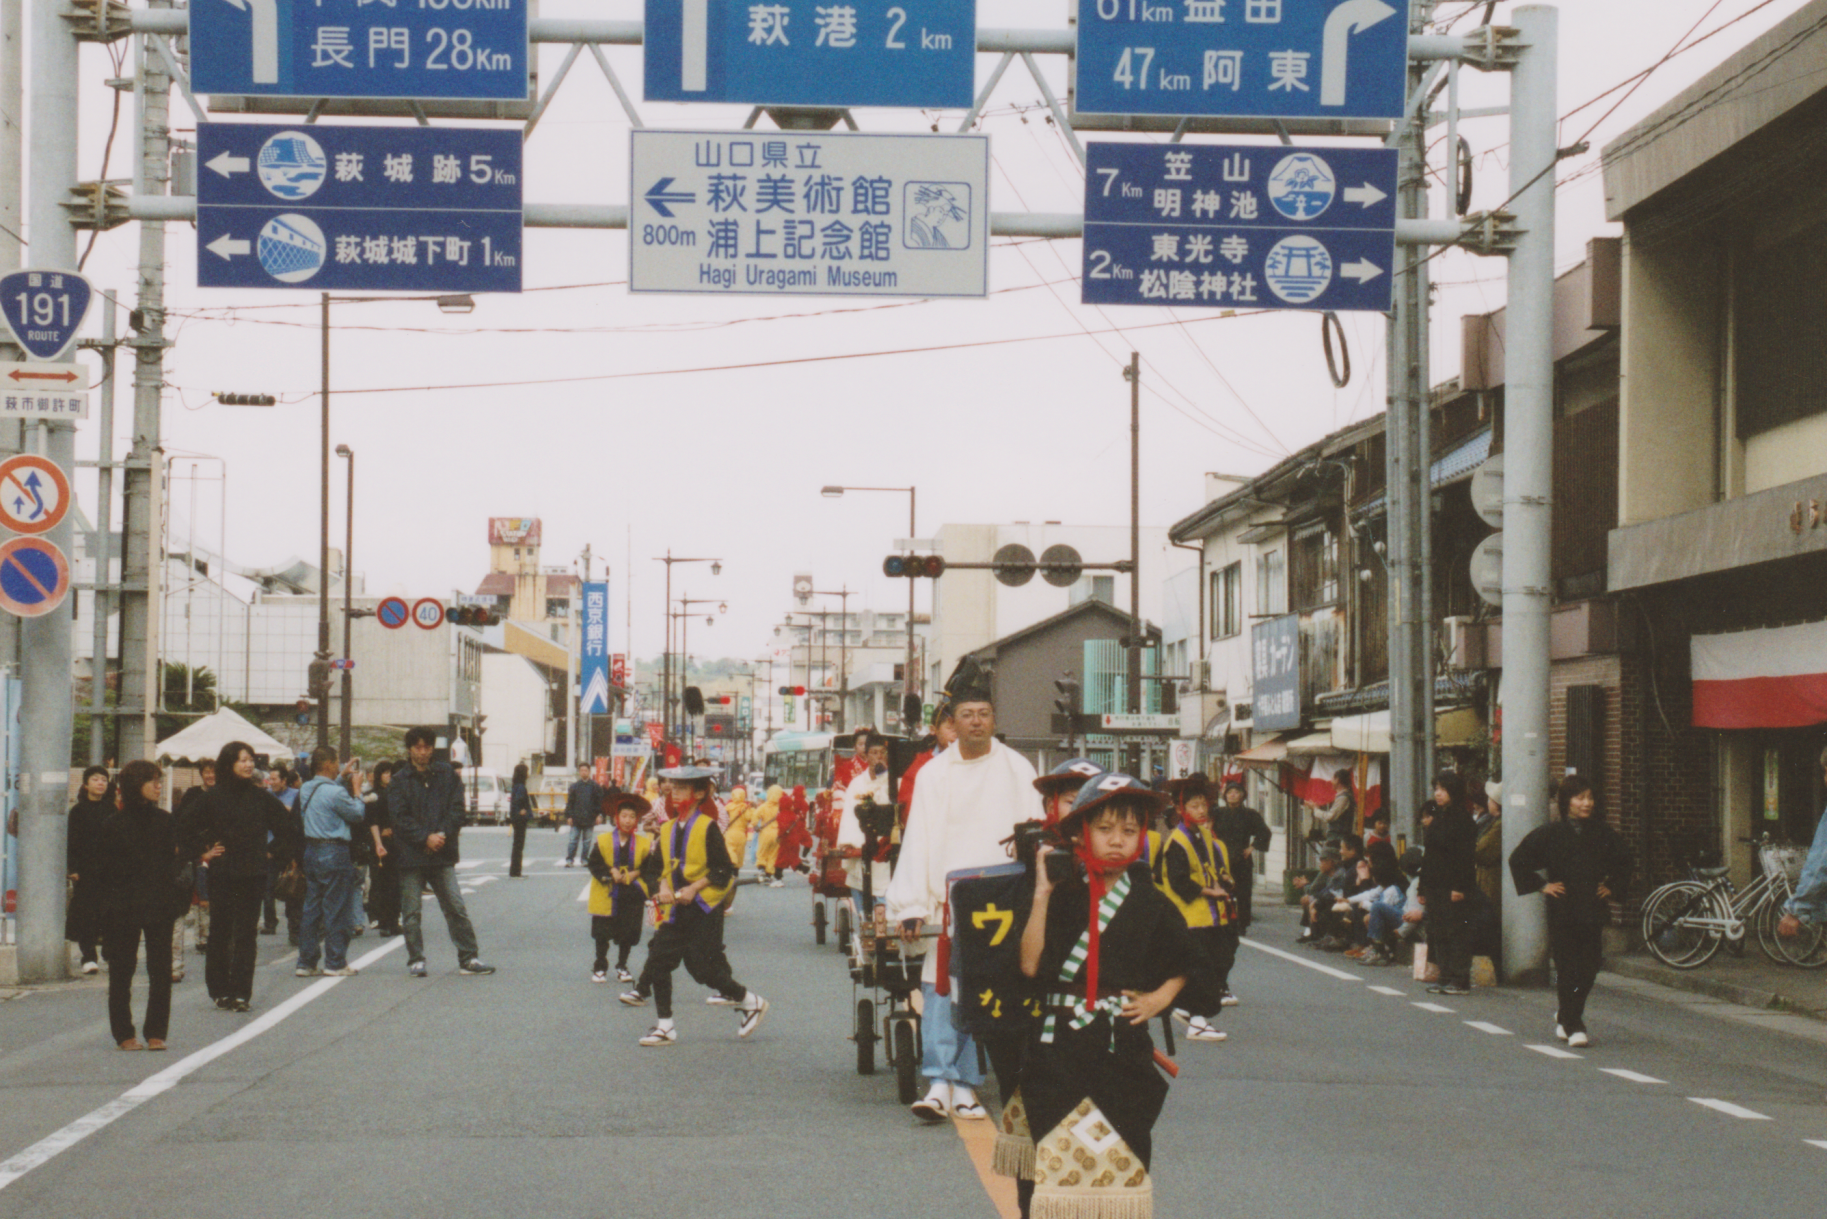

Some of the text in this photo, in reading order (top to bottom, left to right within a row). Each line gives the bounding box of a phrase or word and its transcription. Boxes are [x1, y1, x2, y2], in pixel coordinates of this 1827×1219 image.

[748, 4, 952, 50] 萩港 2 km
[311, 26, 409, 69] 長門
[1203, 49, 1311, 92] 阿東
[335, 153, 461, 184] 萩城跡
[695, 140, 823, 169] 山口県立
[1163, 151, 1251, 182] 笠山
[706, 173, 893, 216] 萩美術館
[1153, 188, 1258, 220] 明神池
[335, 235, 471, 266] 萩城城下町
[643, 224, 697, 247] 800m
[706, 218, 893, 262] 浦上記念館
[1151, 233, 1249, 264] 東光寺
[28, 273, 64, 289] 国道
[699, 263, 898, 290] Hagi Uragami Museum
[1139, 269, 1258, 301] 松陰神社
[15, 292, 70, 327] 191
[27, 330, 60, 342] ROUTE
[5, 396, 81, 413] 萩市御許町
[418, 606, 438, 621] 40
[586, 591, 604, 656] 西京銀行
